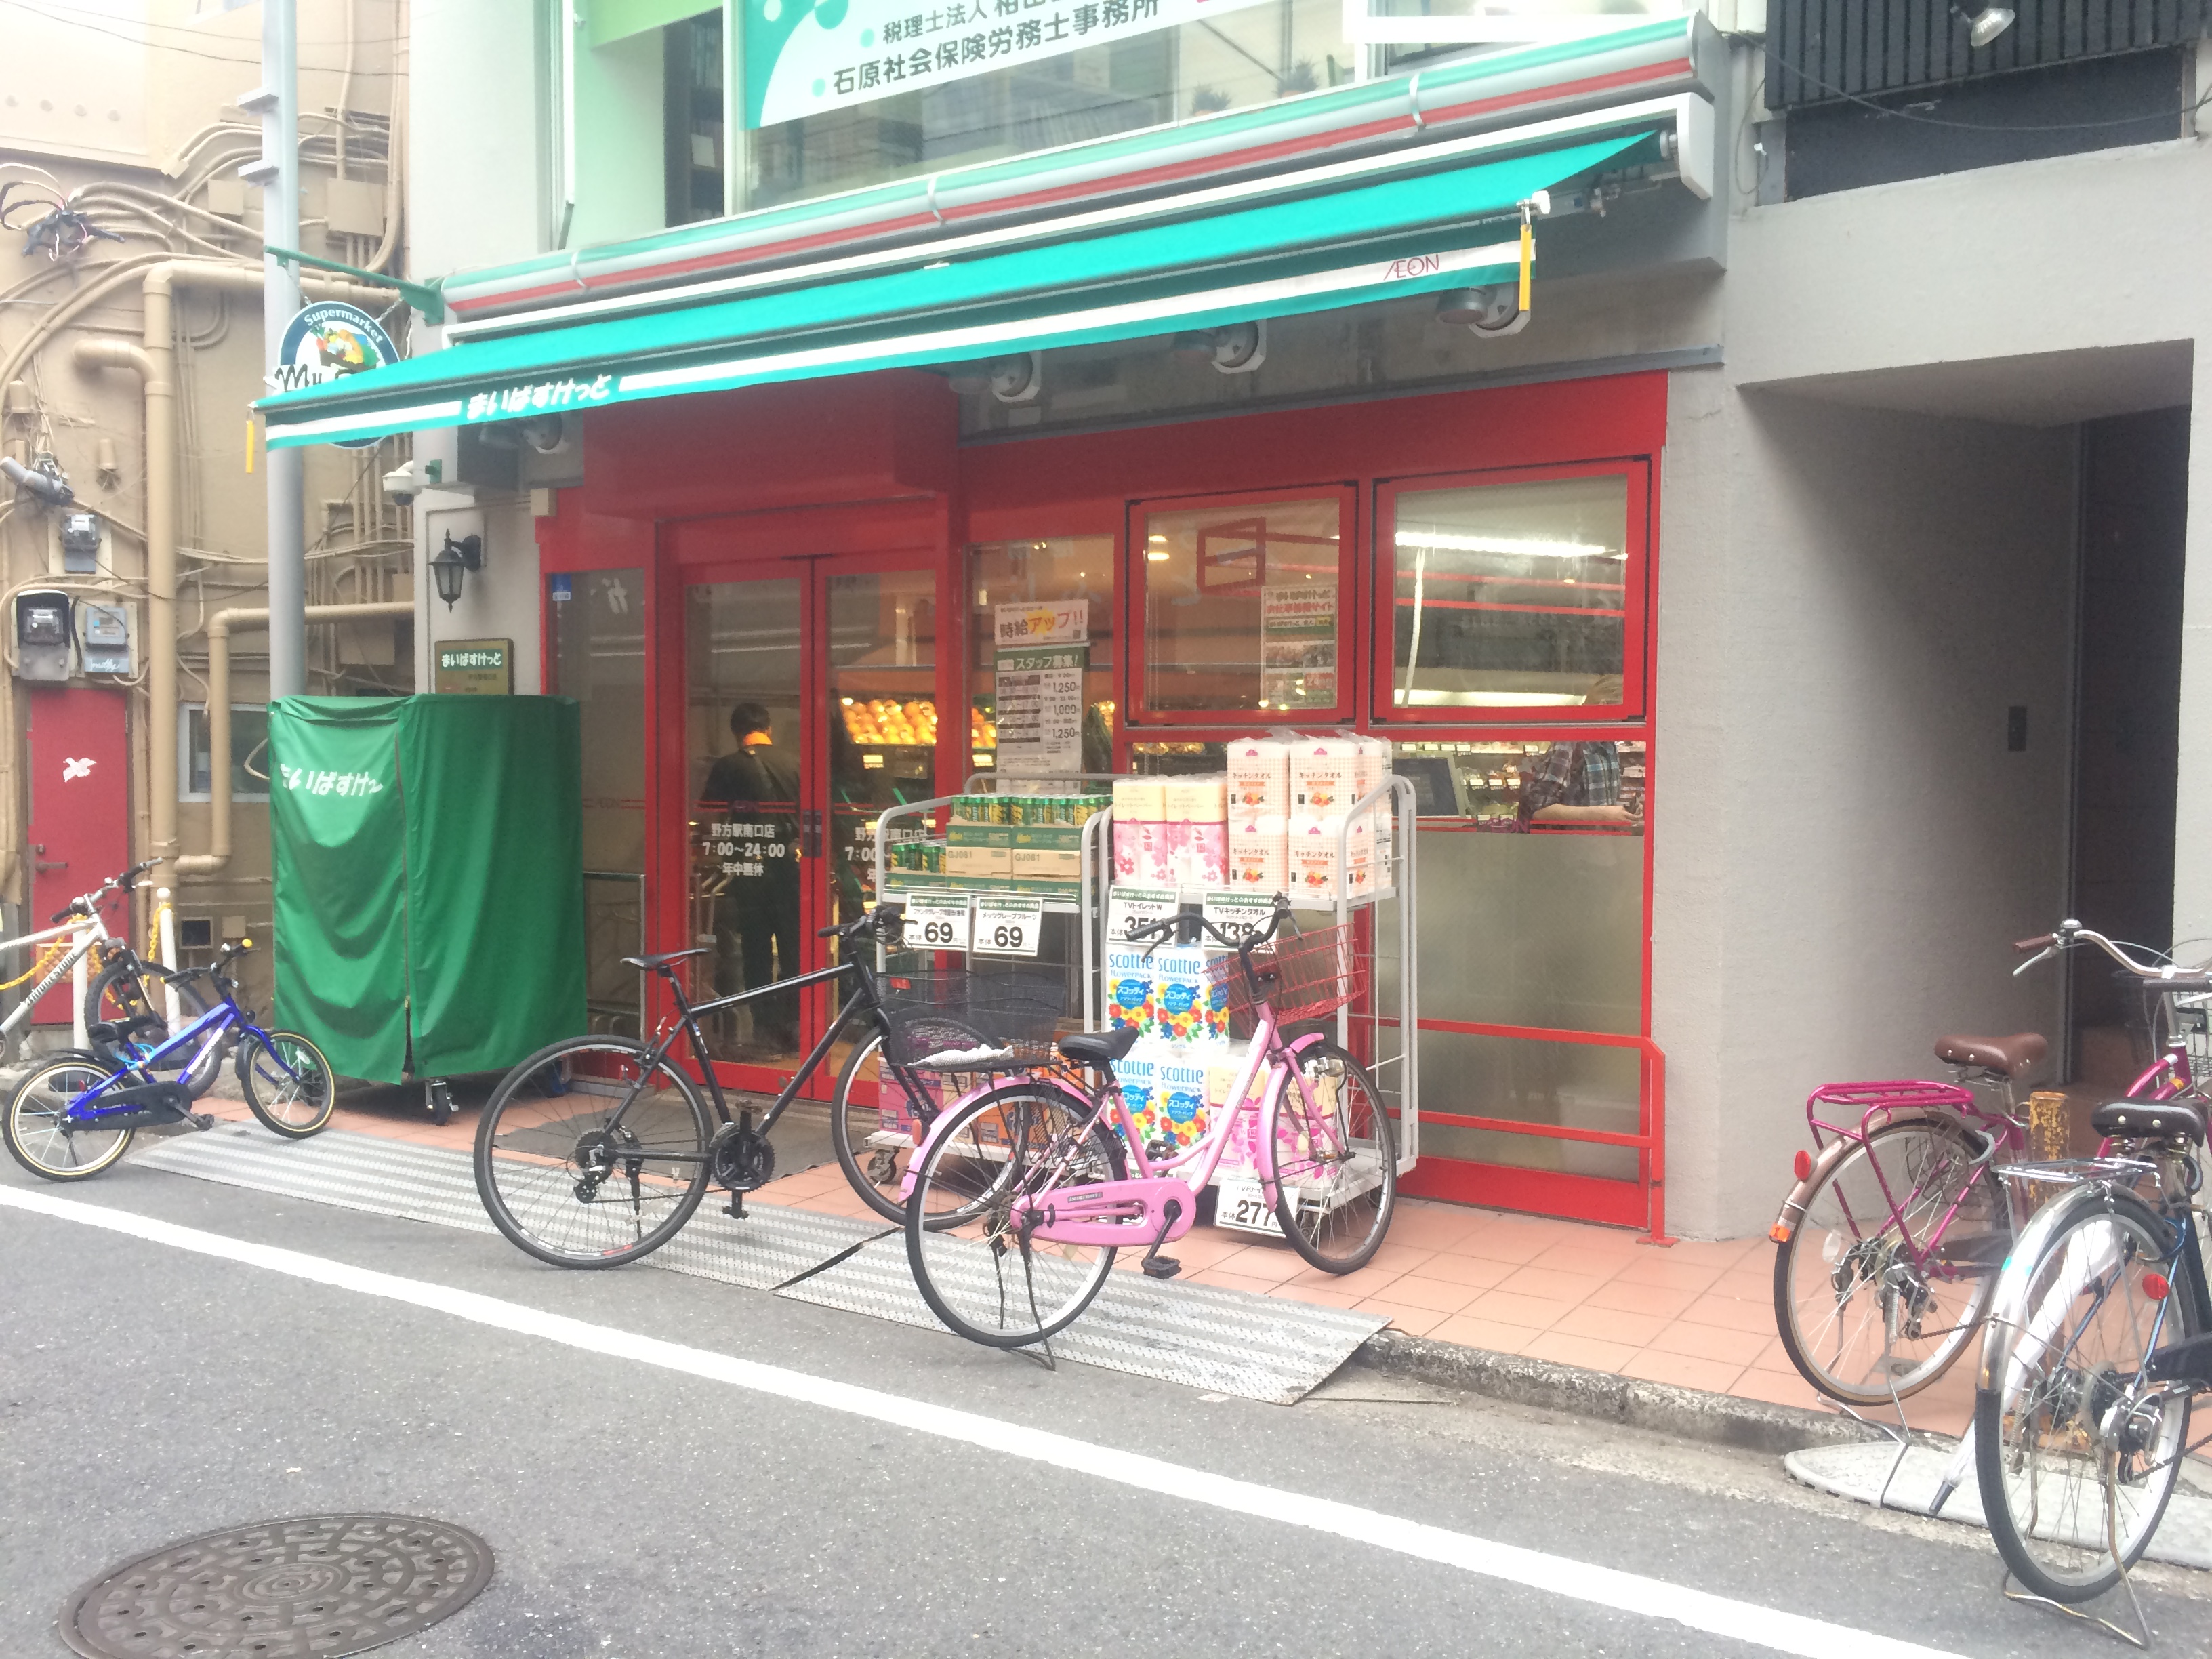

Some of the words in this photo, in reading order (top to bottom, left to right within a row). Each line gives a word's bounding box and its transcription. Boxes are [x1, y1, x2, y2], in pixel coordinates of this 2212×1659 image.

[833, 0, 1158, 95] 石原社会保険労務士事務所
[304, 309, 384, 344] Supermarket
[466, 374, 612, 420] まいばすけっと
[441, 652, 502, 668] まいばすけっと
[924, 922, 954, 943] 69
[994, 926, 1023, 948] 69
[1158, 958, 1201, 975] scottie
[1110, 1059, 1155, 1076] scottie
[1160, 1066, 1204, 1084] scottie
[1235, 1199, 1270, 1227] 277
